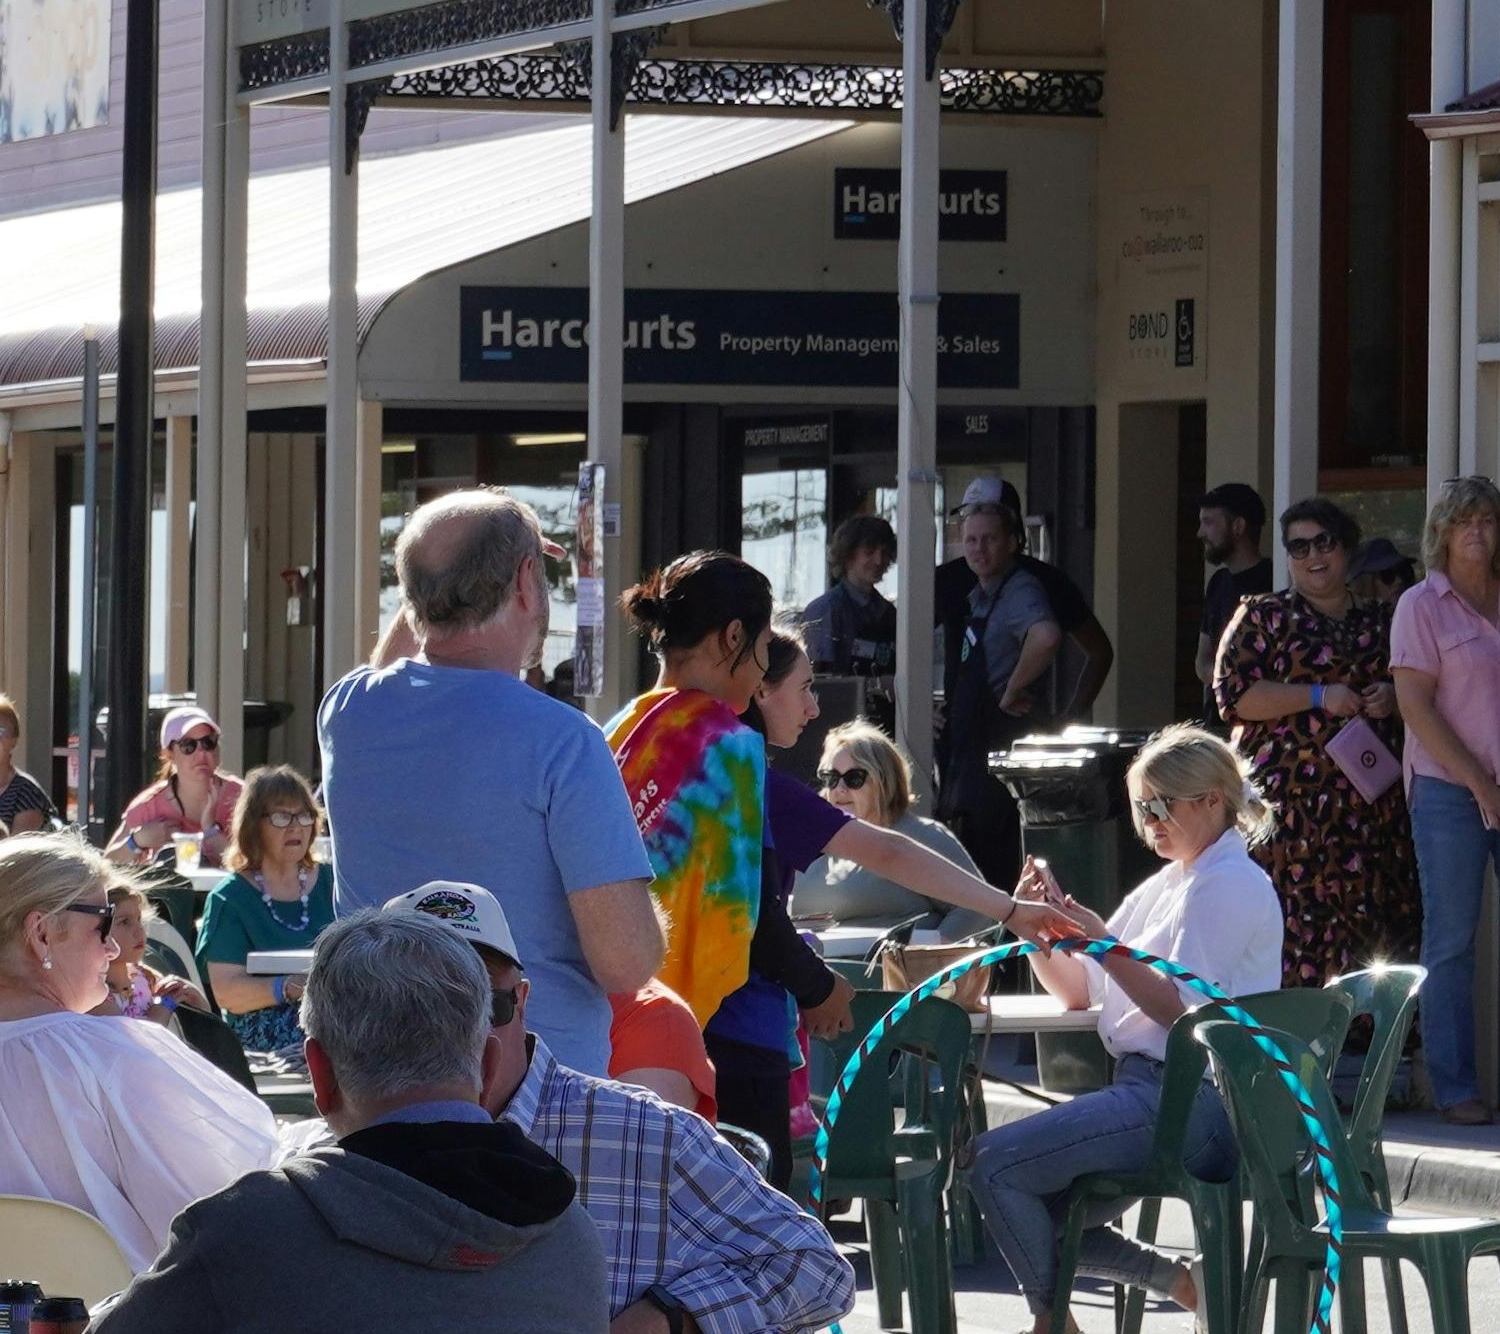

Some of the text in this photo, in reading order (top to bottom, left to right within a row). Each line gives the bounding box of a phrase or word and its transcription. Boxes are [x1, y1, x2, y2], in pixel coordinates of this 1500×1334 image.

[842, 185, 1001, 215] Harurts
[481, 310, 696, 350] Harcurts
[1128, 313, 1168, 340] BOND
[719, 332, 802, 355] Property
[806, 334, 899, 356] Managem
[952, 336, 1001, 354] Sales
[745, 423, 828, 446] PROPERTY MANAGEMENT
[965, 416, 989, 434] SALES
